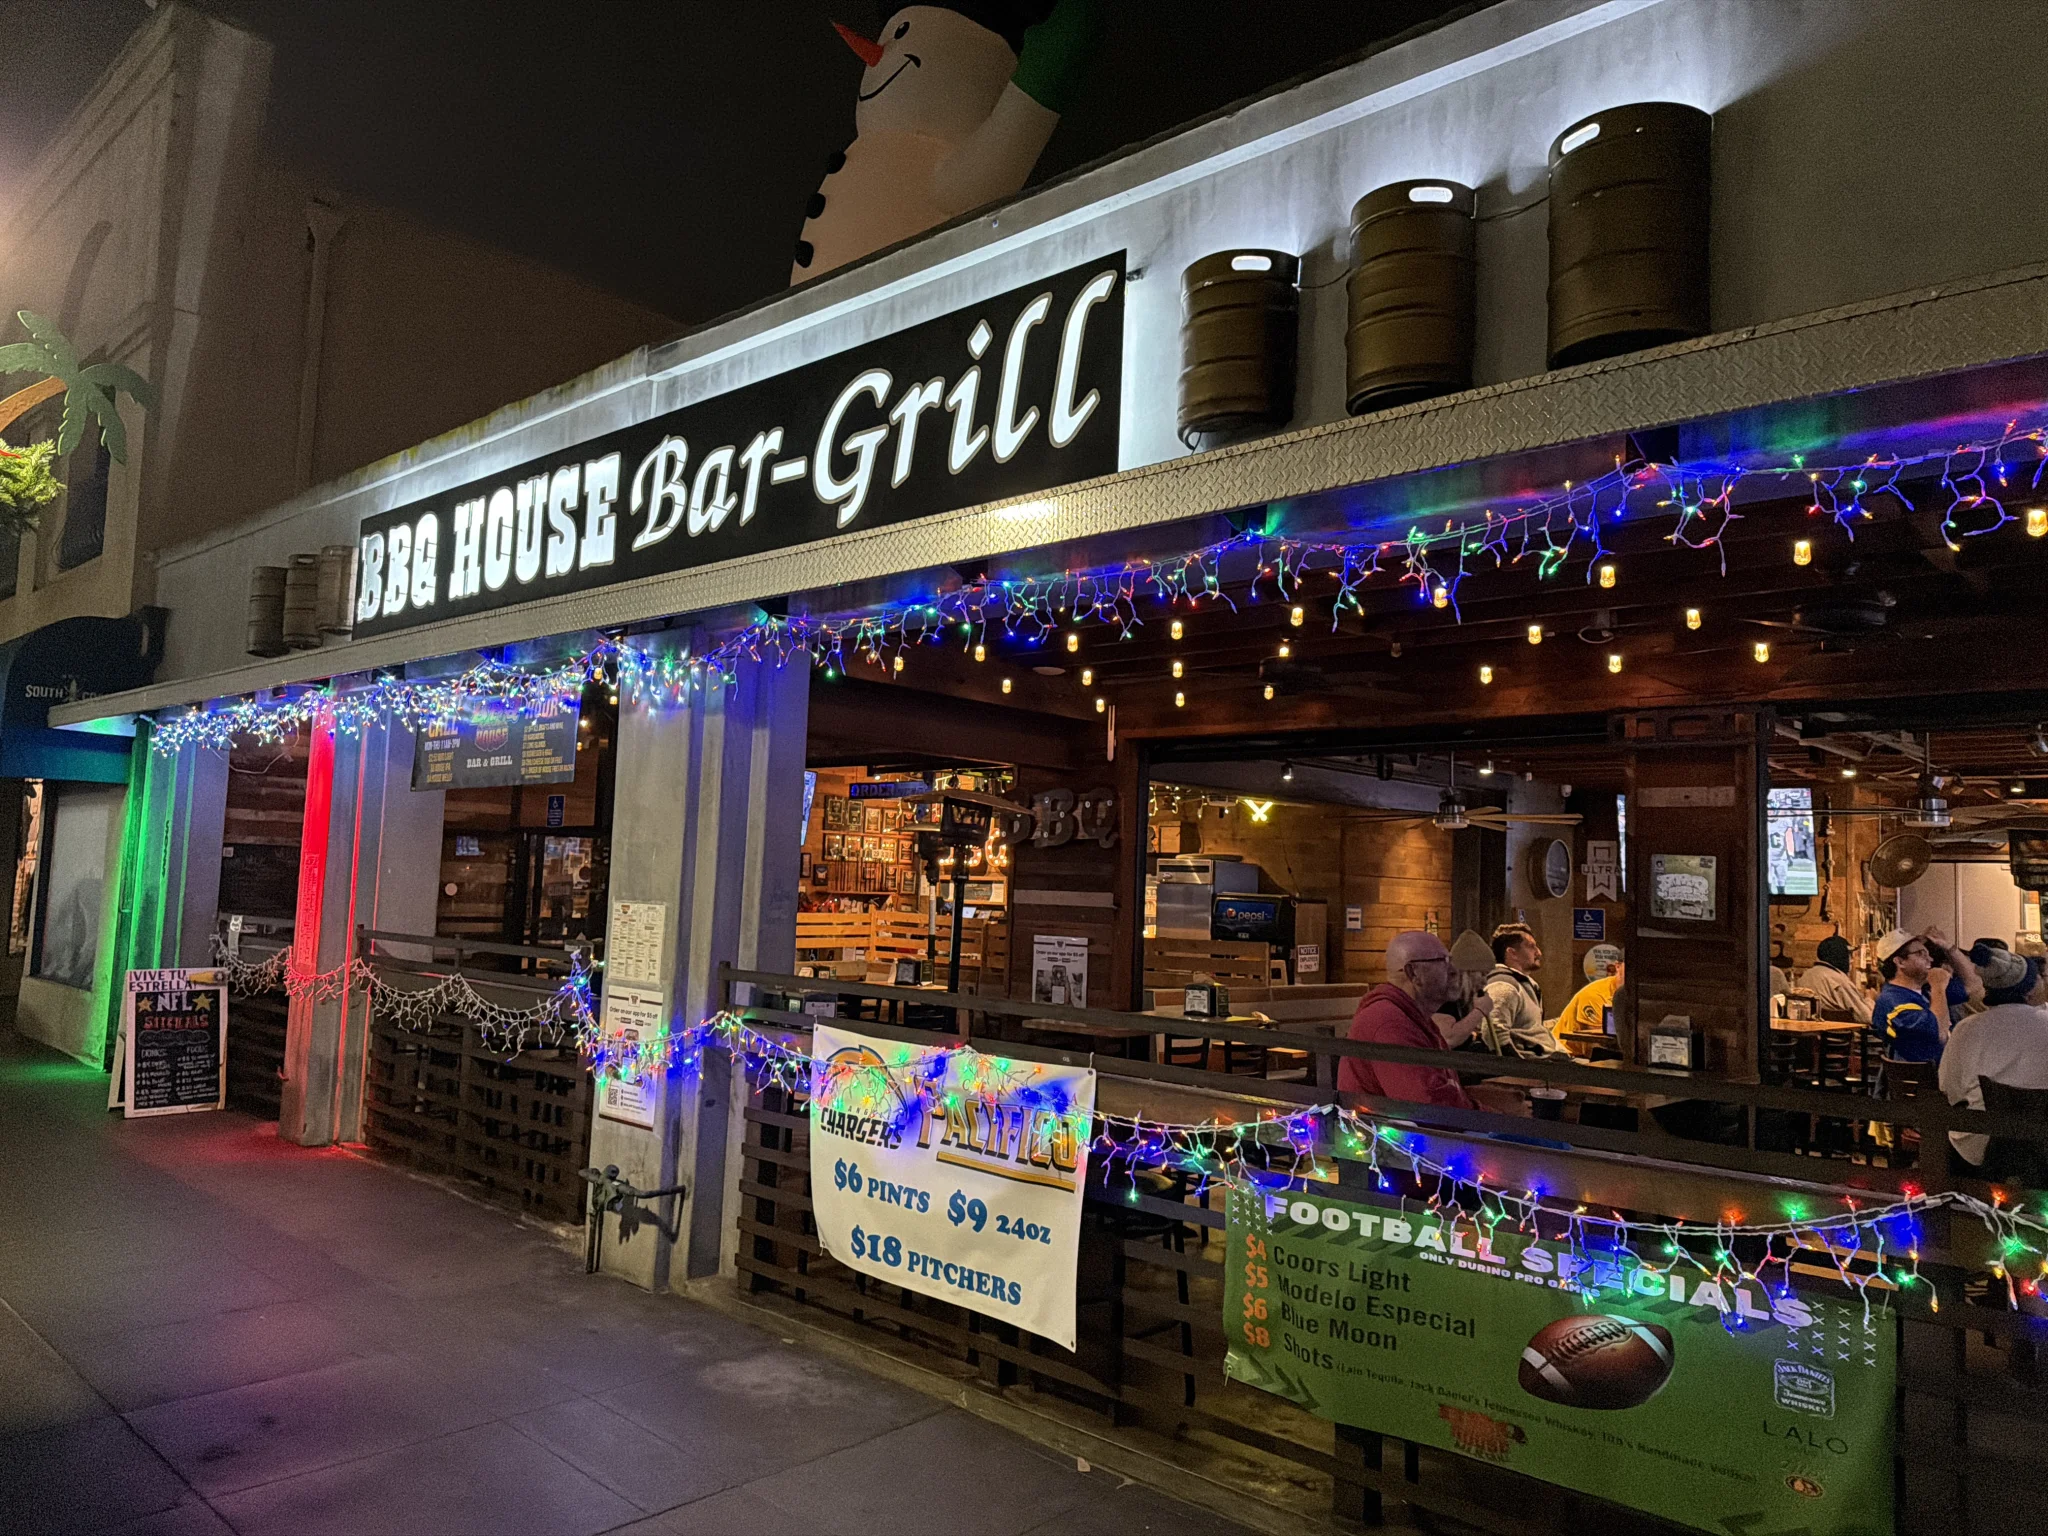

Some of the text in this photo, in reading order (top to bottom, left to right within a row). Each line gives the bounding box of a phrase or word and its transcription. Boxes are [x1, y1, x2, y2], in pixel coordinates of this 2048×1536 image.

[357, 269, 1119, 623] BBQ HOUSE Bar-Grill
[25, 684, 64, 698] SOUTH
[467, 755, 513, 768] BAR & GRILL
[851, 784, 895, 797] ORDER
[1582, 866, 1621, 875] ULTRA
[1238, 910, 1265, 923] pepsi
[156, 992, 193, 1012] NFL
[820, 1073, 1081, 1174] CHARGERS PACIFICO
[834, 1157, 863, 1193] $6
[867, 1176, 931, 1213] PINTS
[947, 1189, 988, 1233] $9
[850, 1224, 1022, 1306] $18 PITCHERS
[1245, 1233, 1411, 1293] $4 Coors Light
[1265, 1194, 1813, 1328] FOOTBALL SPECIALS
[1419, 1251, 1455, 1266] ONLY
[1458, 1259, 1511, 1278] DURING
[1514, 1271, 1544, 1285] PRO
[1245, 1262, 1476, 1339] $5 Modelo Especial
[1243, 1293, 1398, 1351] $6 Blue Moon
[1243, 1321, 1270, 1348] $8
[1283, 1332, 1334, 1370] Shots
[1781, 1397, 1829, 1414] WHISKEY
[1763, 1419, 1849, 1455] LALO
